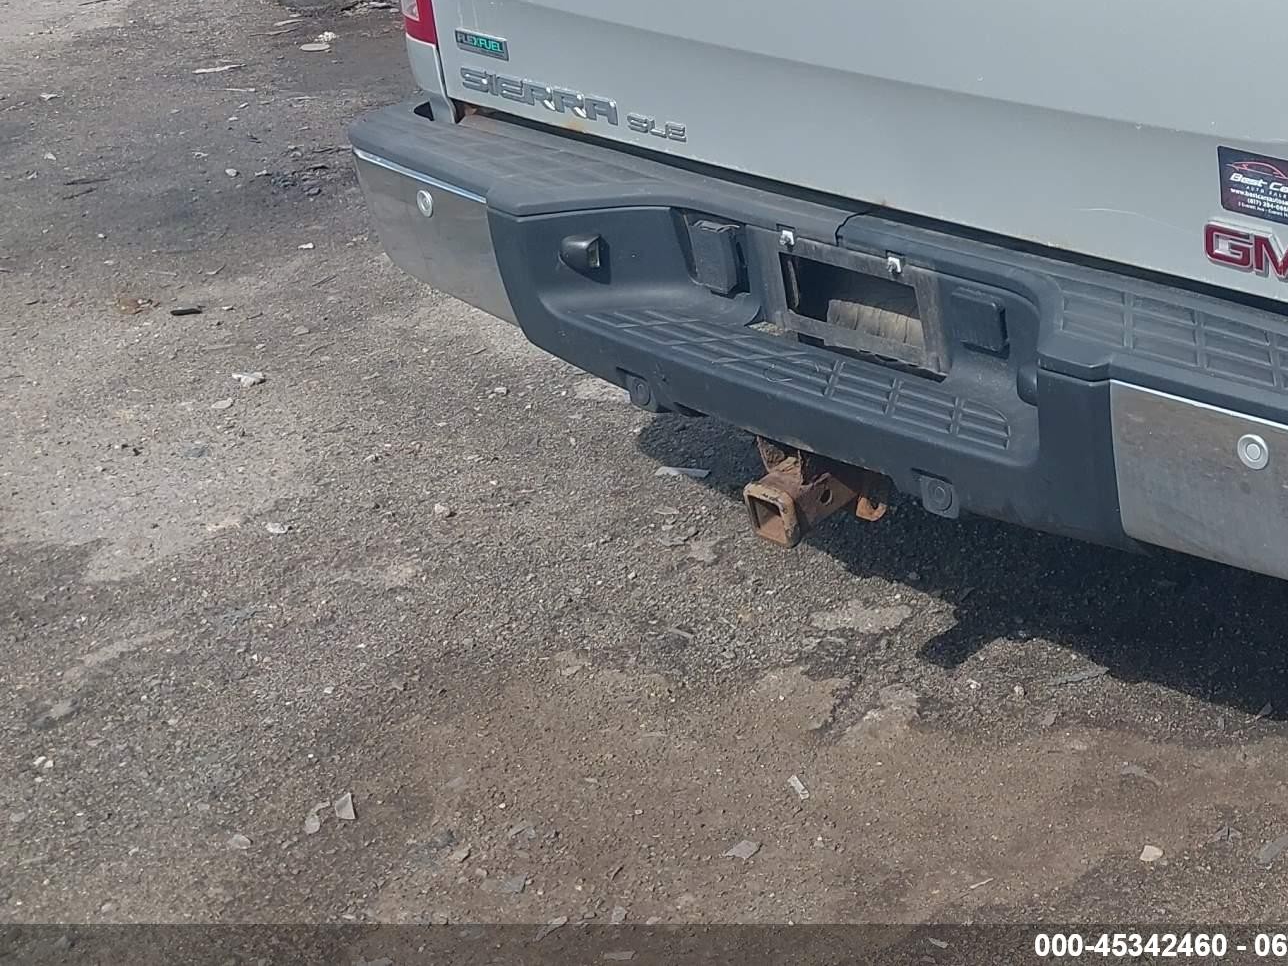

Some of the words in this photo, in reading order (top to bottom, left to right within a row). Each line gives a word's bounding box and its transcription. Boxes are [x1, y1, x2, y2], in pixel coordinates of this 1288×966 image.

[460, 66, 619, 125] SIERRA
[626, 112, 687, 143] SLE
[1230, 172, 1268, 187] Best
